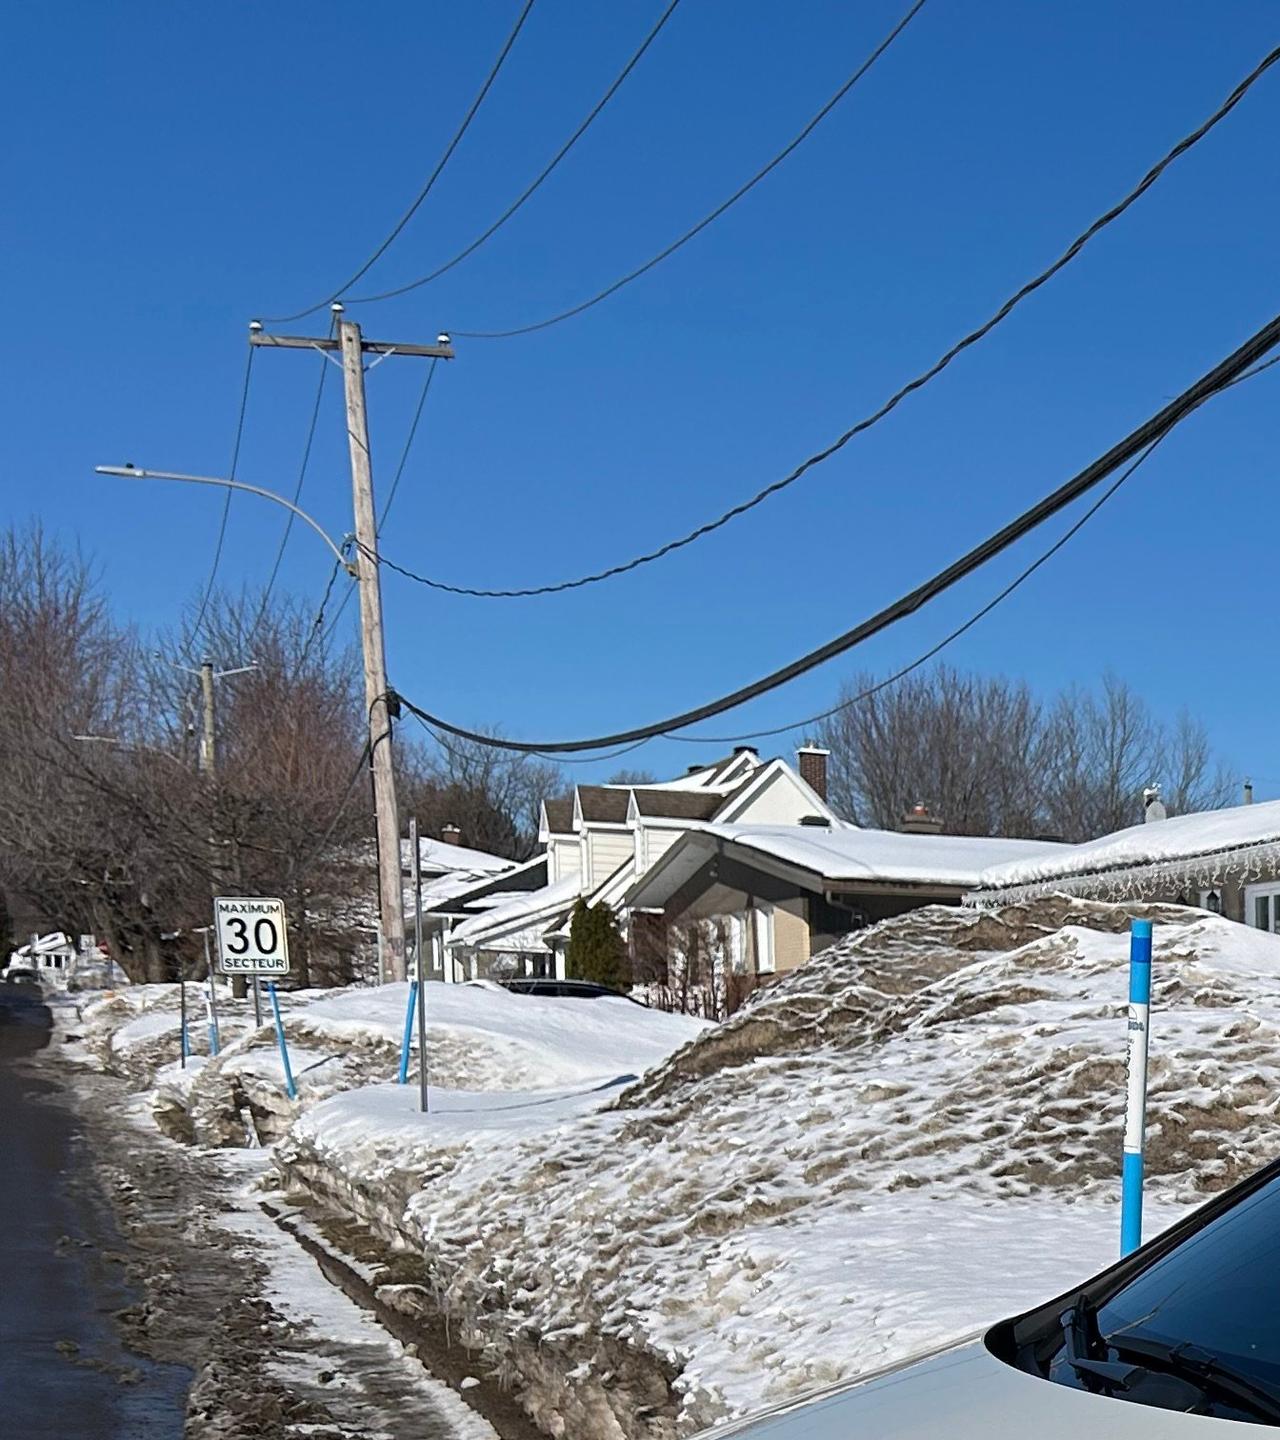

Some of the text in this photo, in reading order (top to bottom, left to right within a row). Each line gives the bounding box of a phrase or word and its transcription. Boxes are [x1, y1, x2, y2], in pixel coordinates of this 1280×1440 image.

[219, 904, 280, 914] MAXIMUM
[226, 918, 278, 955] 30
[224, 958, 284, 969] SECTEUR
